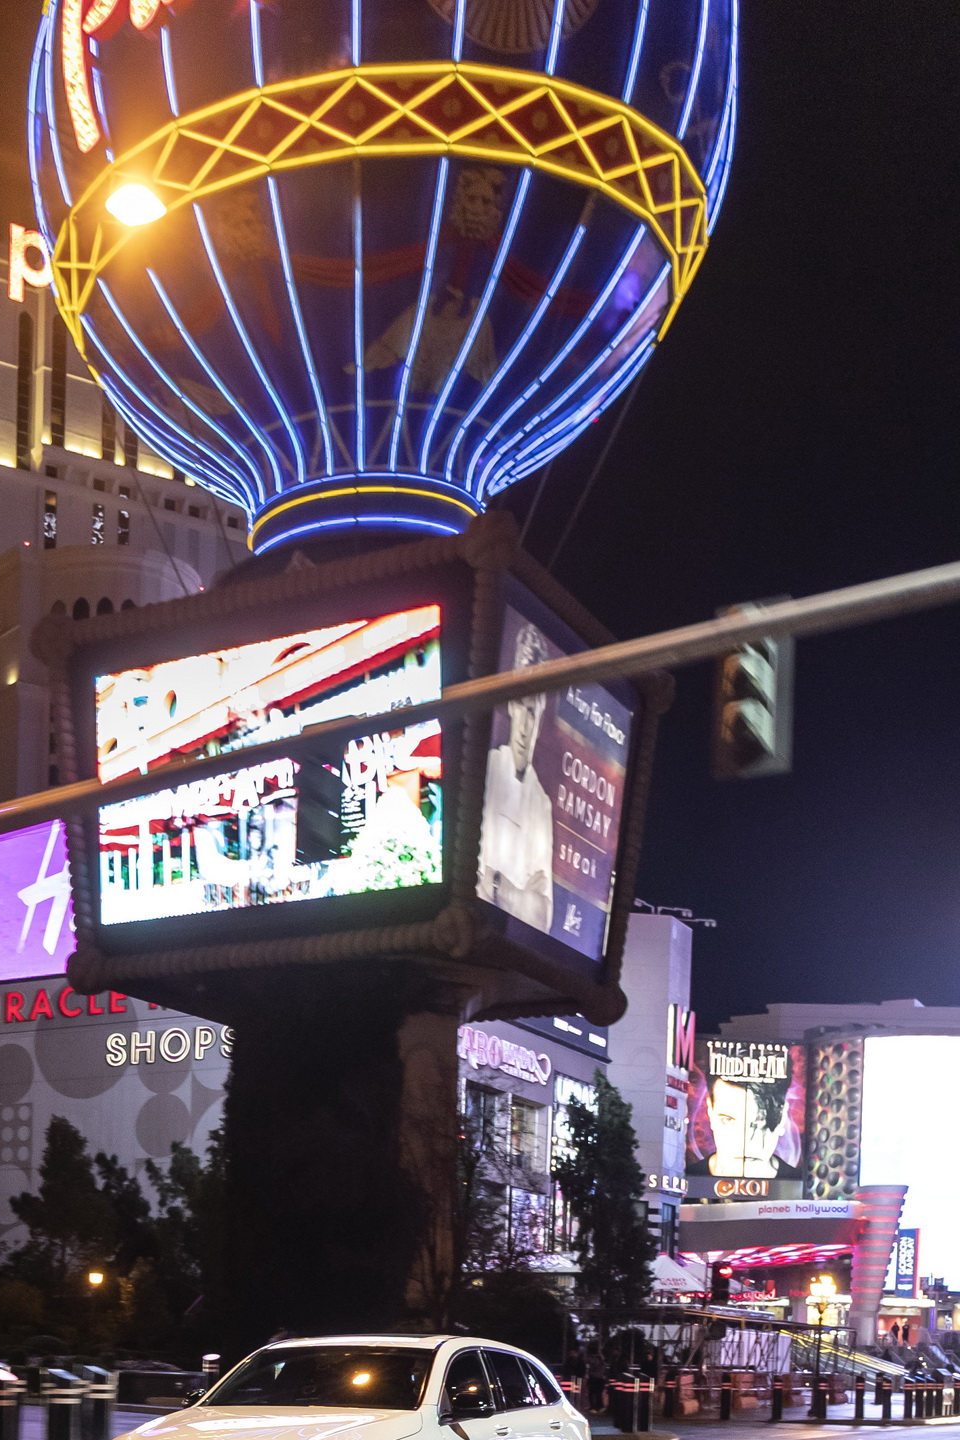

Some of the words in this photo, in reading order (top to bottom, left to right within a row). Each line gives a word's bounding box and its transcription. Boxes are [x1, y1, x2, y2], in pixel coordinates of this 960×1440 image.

[561, 751, 616, 808] GORDON
[556, 784, 612, 838] RAMSAY
[559, 844, 597, 879] steak
[105, 1025, 236, 1067] SHOPS
[732, 1179, 770, 1196] KOI
[758, 1204, 791, 1215] planet
[795, 1203, 849, 1215] hollywood
